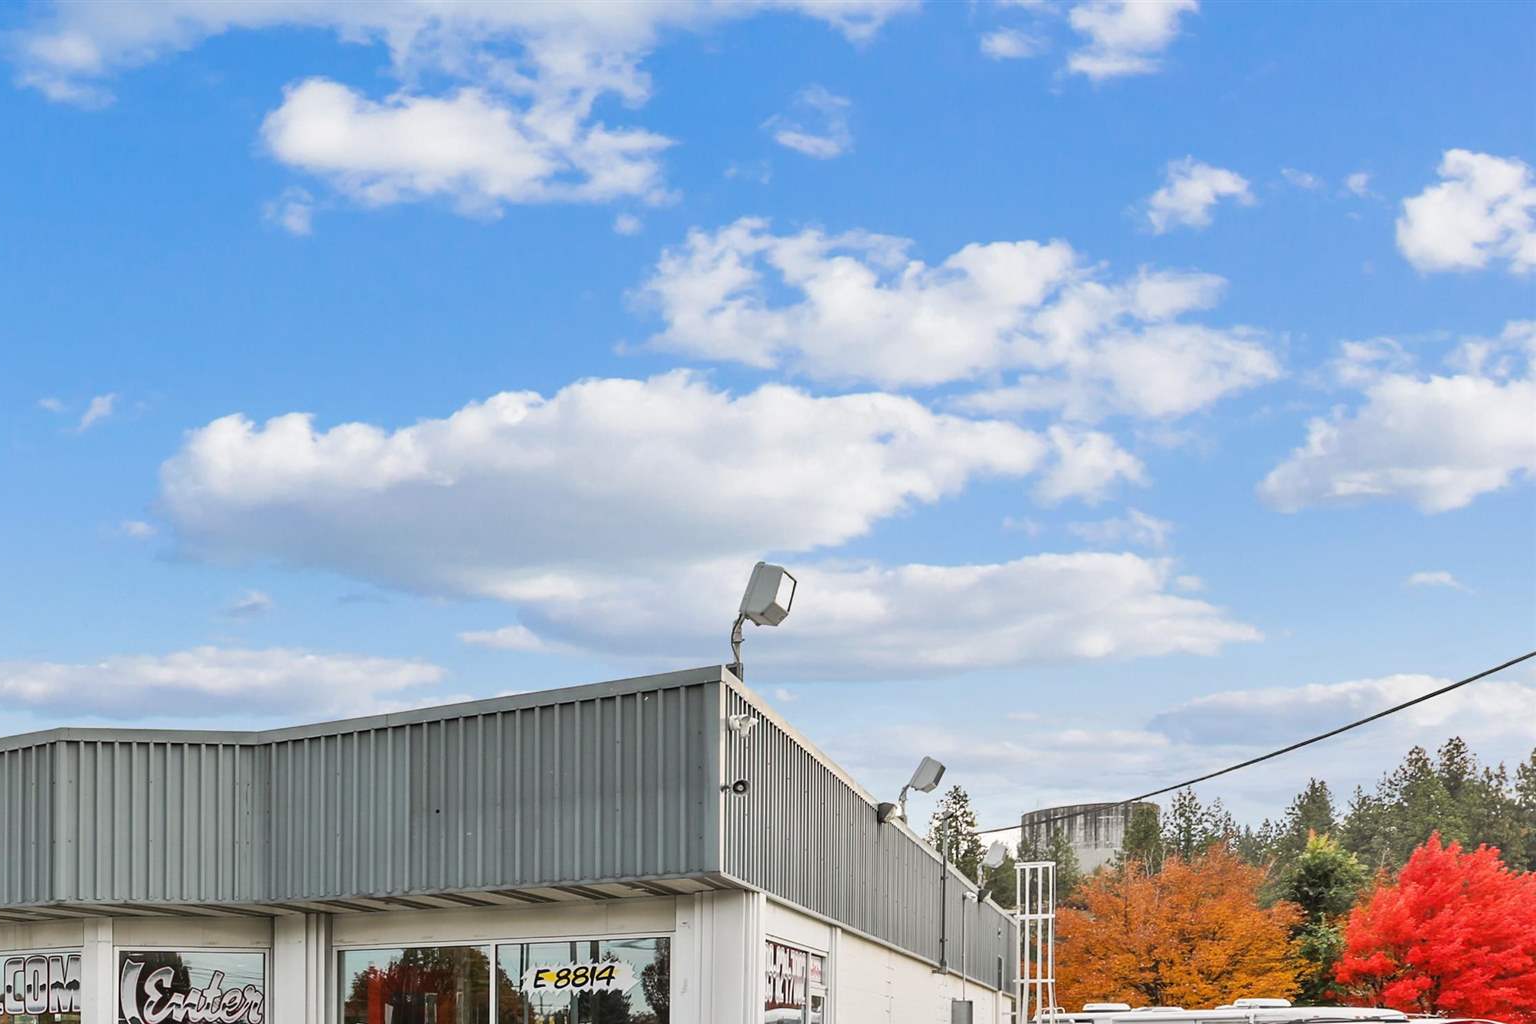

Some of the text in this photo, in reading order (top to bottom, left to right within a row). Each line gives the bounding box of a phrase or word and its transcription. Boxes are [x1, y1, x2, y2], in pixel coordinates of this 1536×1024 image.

[143, 966, 263, 1024] Enter
[533, 965, 616, 989] E 8814
